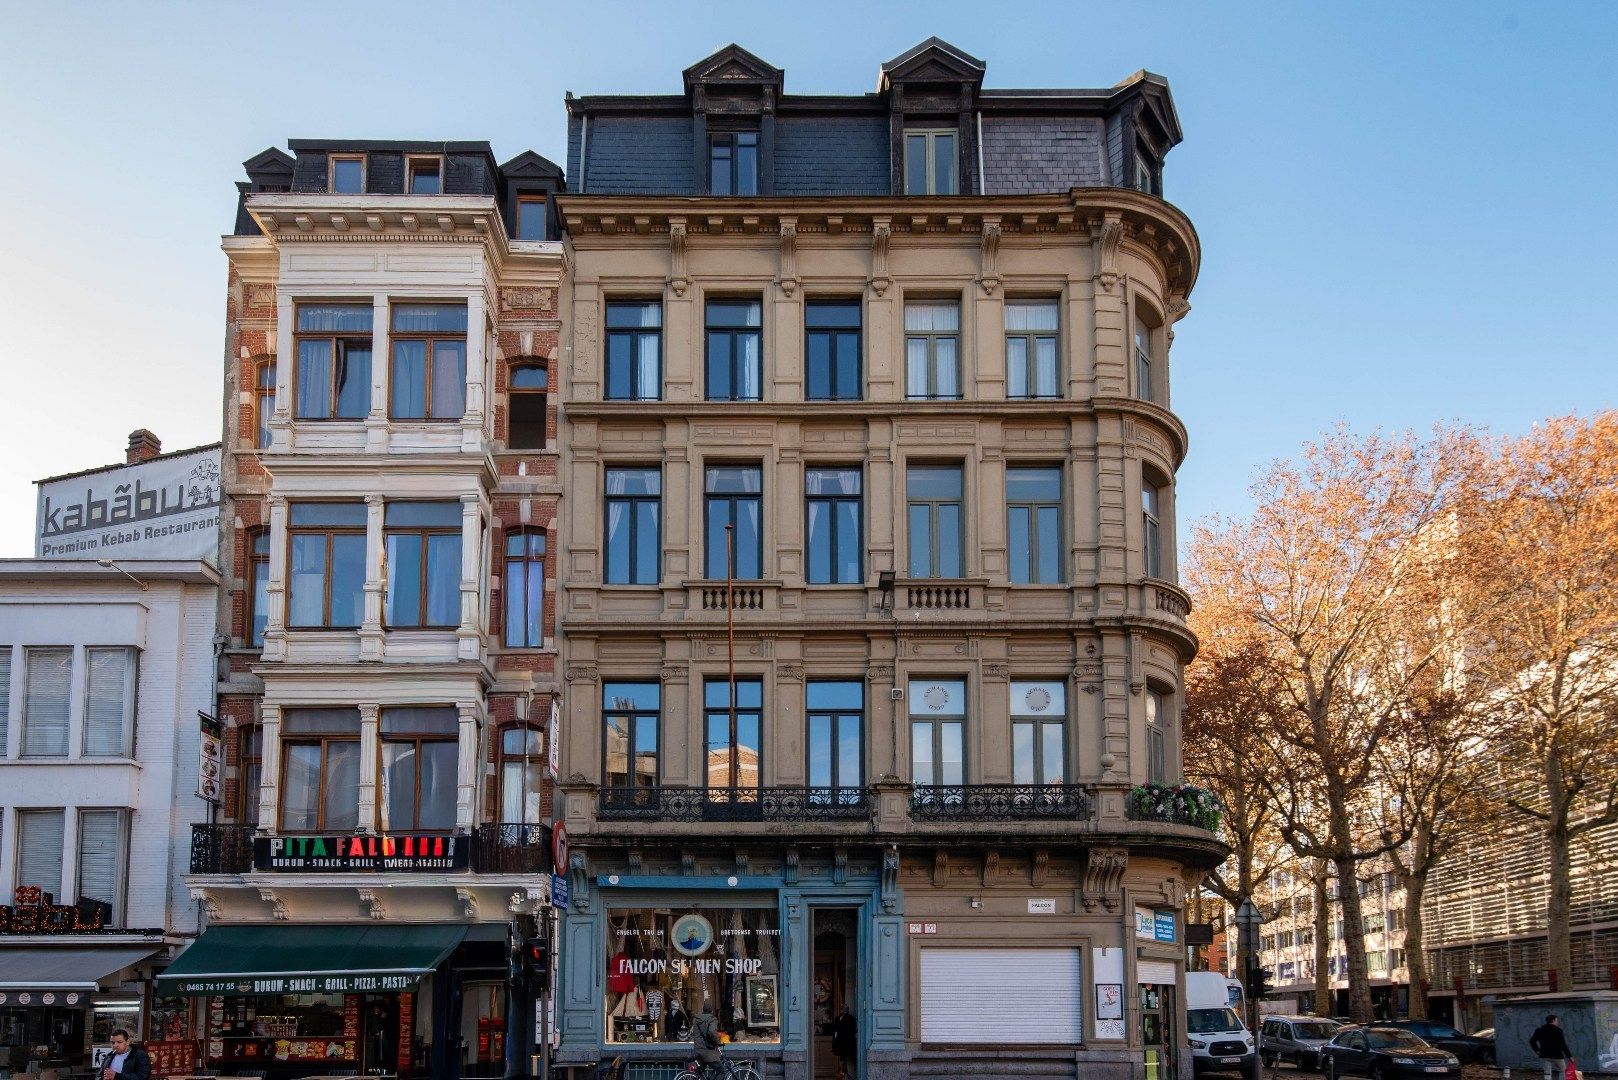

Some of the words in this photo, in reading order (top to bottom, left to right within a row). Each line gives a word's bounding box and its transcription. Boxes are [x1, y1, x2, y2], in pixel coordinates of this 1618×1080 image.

[42, 479, 184, 537] kabãbu
[42, 540, 97, 556] Premium
[101, 531, 140, 547] Kebab
[271, 837, 327, 856] PITA
[312, 858, 341, 867] SNACK
[349, 858, 374, 867] GRILL
[619, 958, 666, 974] FALCON
[725, 958, 762, 974] SHOP
[205, 983, 214, 991] 74
[215, 982, 224, 991] 17
[226, 982, 235, 990] 55
[254, 979, 283, 993] DURUM
[289, 978, 316, 991] SNACK
[325, 977, 348, 990] GRILL
[354, 977, 376, 990] PIZZA
[382, 976, 407, 989] PASTA
[792, 995, 797, 1006] 2
